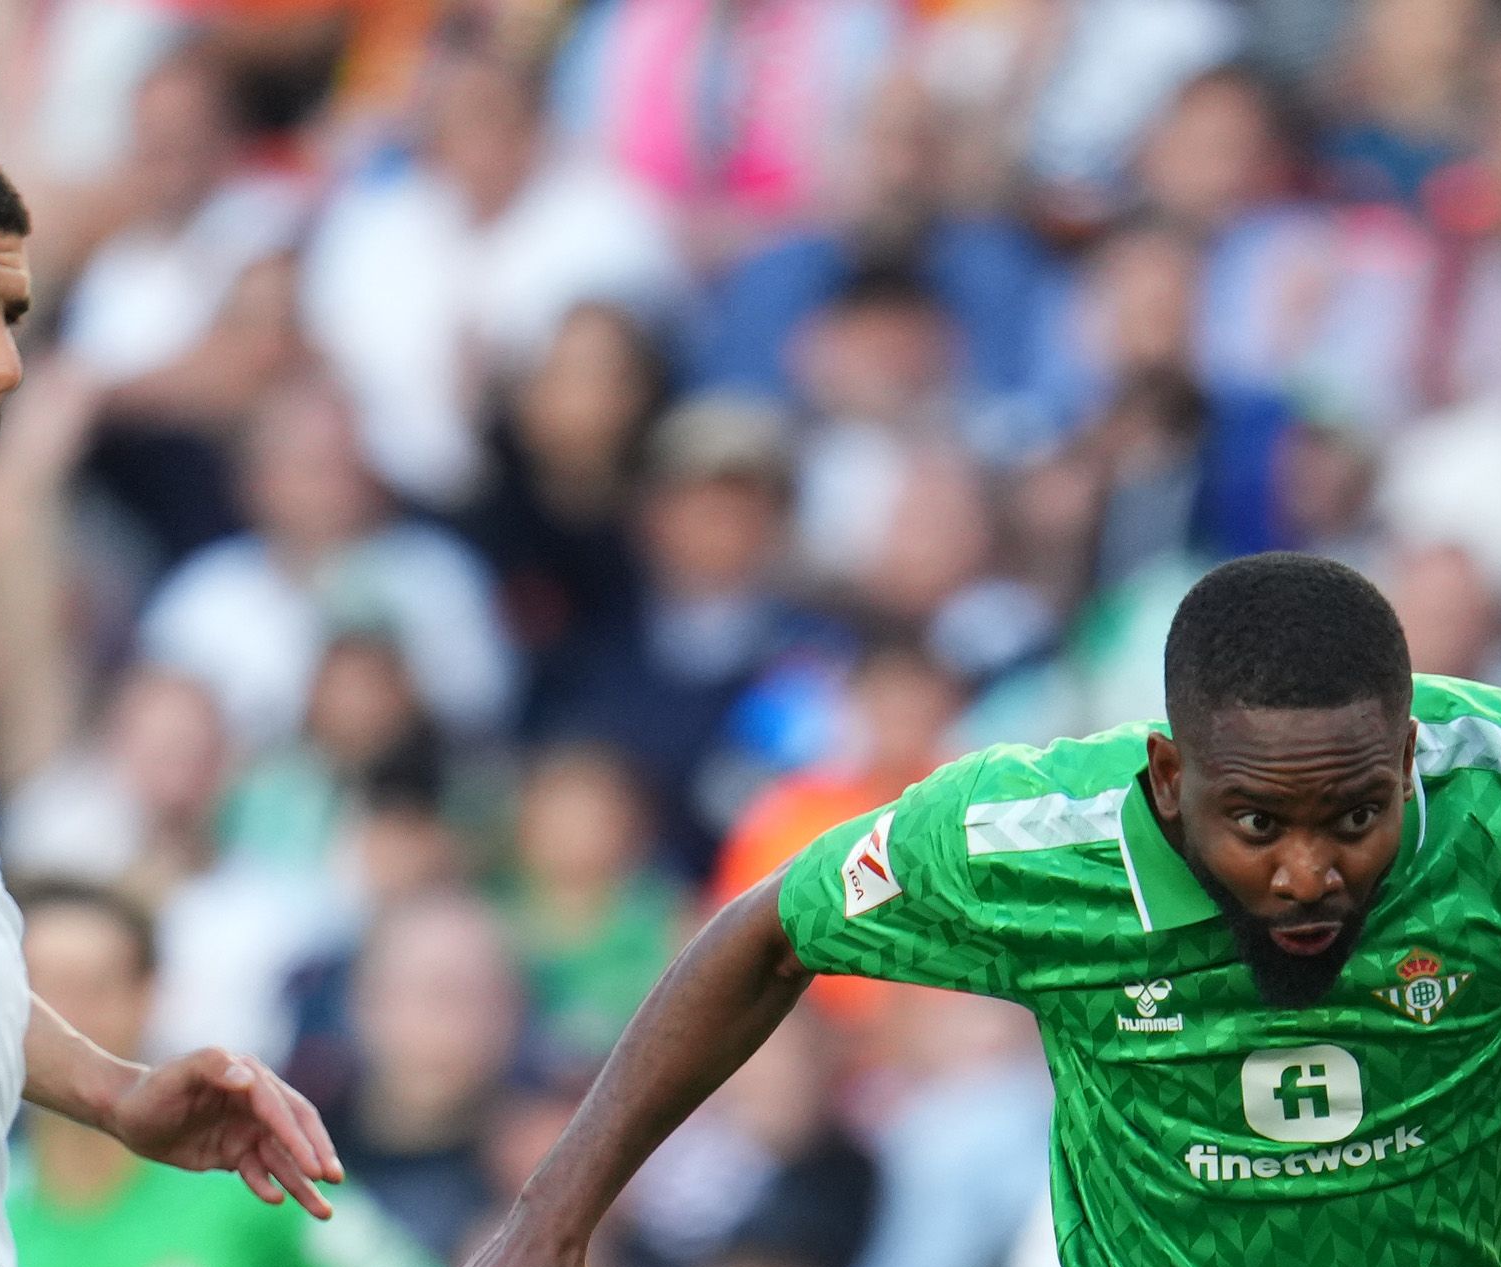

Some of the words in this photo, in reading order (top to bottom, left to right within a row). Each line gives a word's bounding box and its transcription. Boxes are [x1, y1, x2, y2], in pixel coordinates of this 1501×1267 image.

[1117, 1012, 1183, 1033] hummel
[1272, 1063, 1331, 1121] fi
[1184, 1123, 1426, 1182] finetwork
